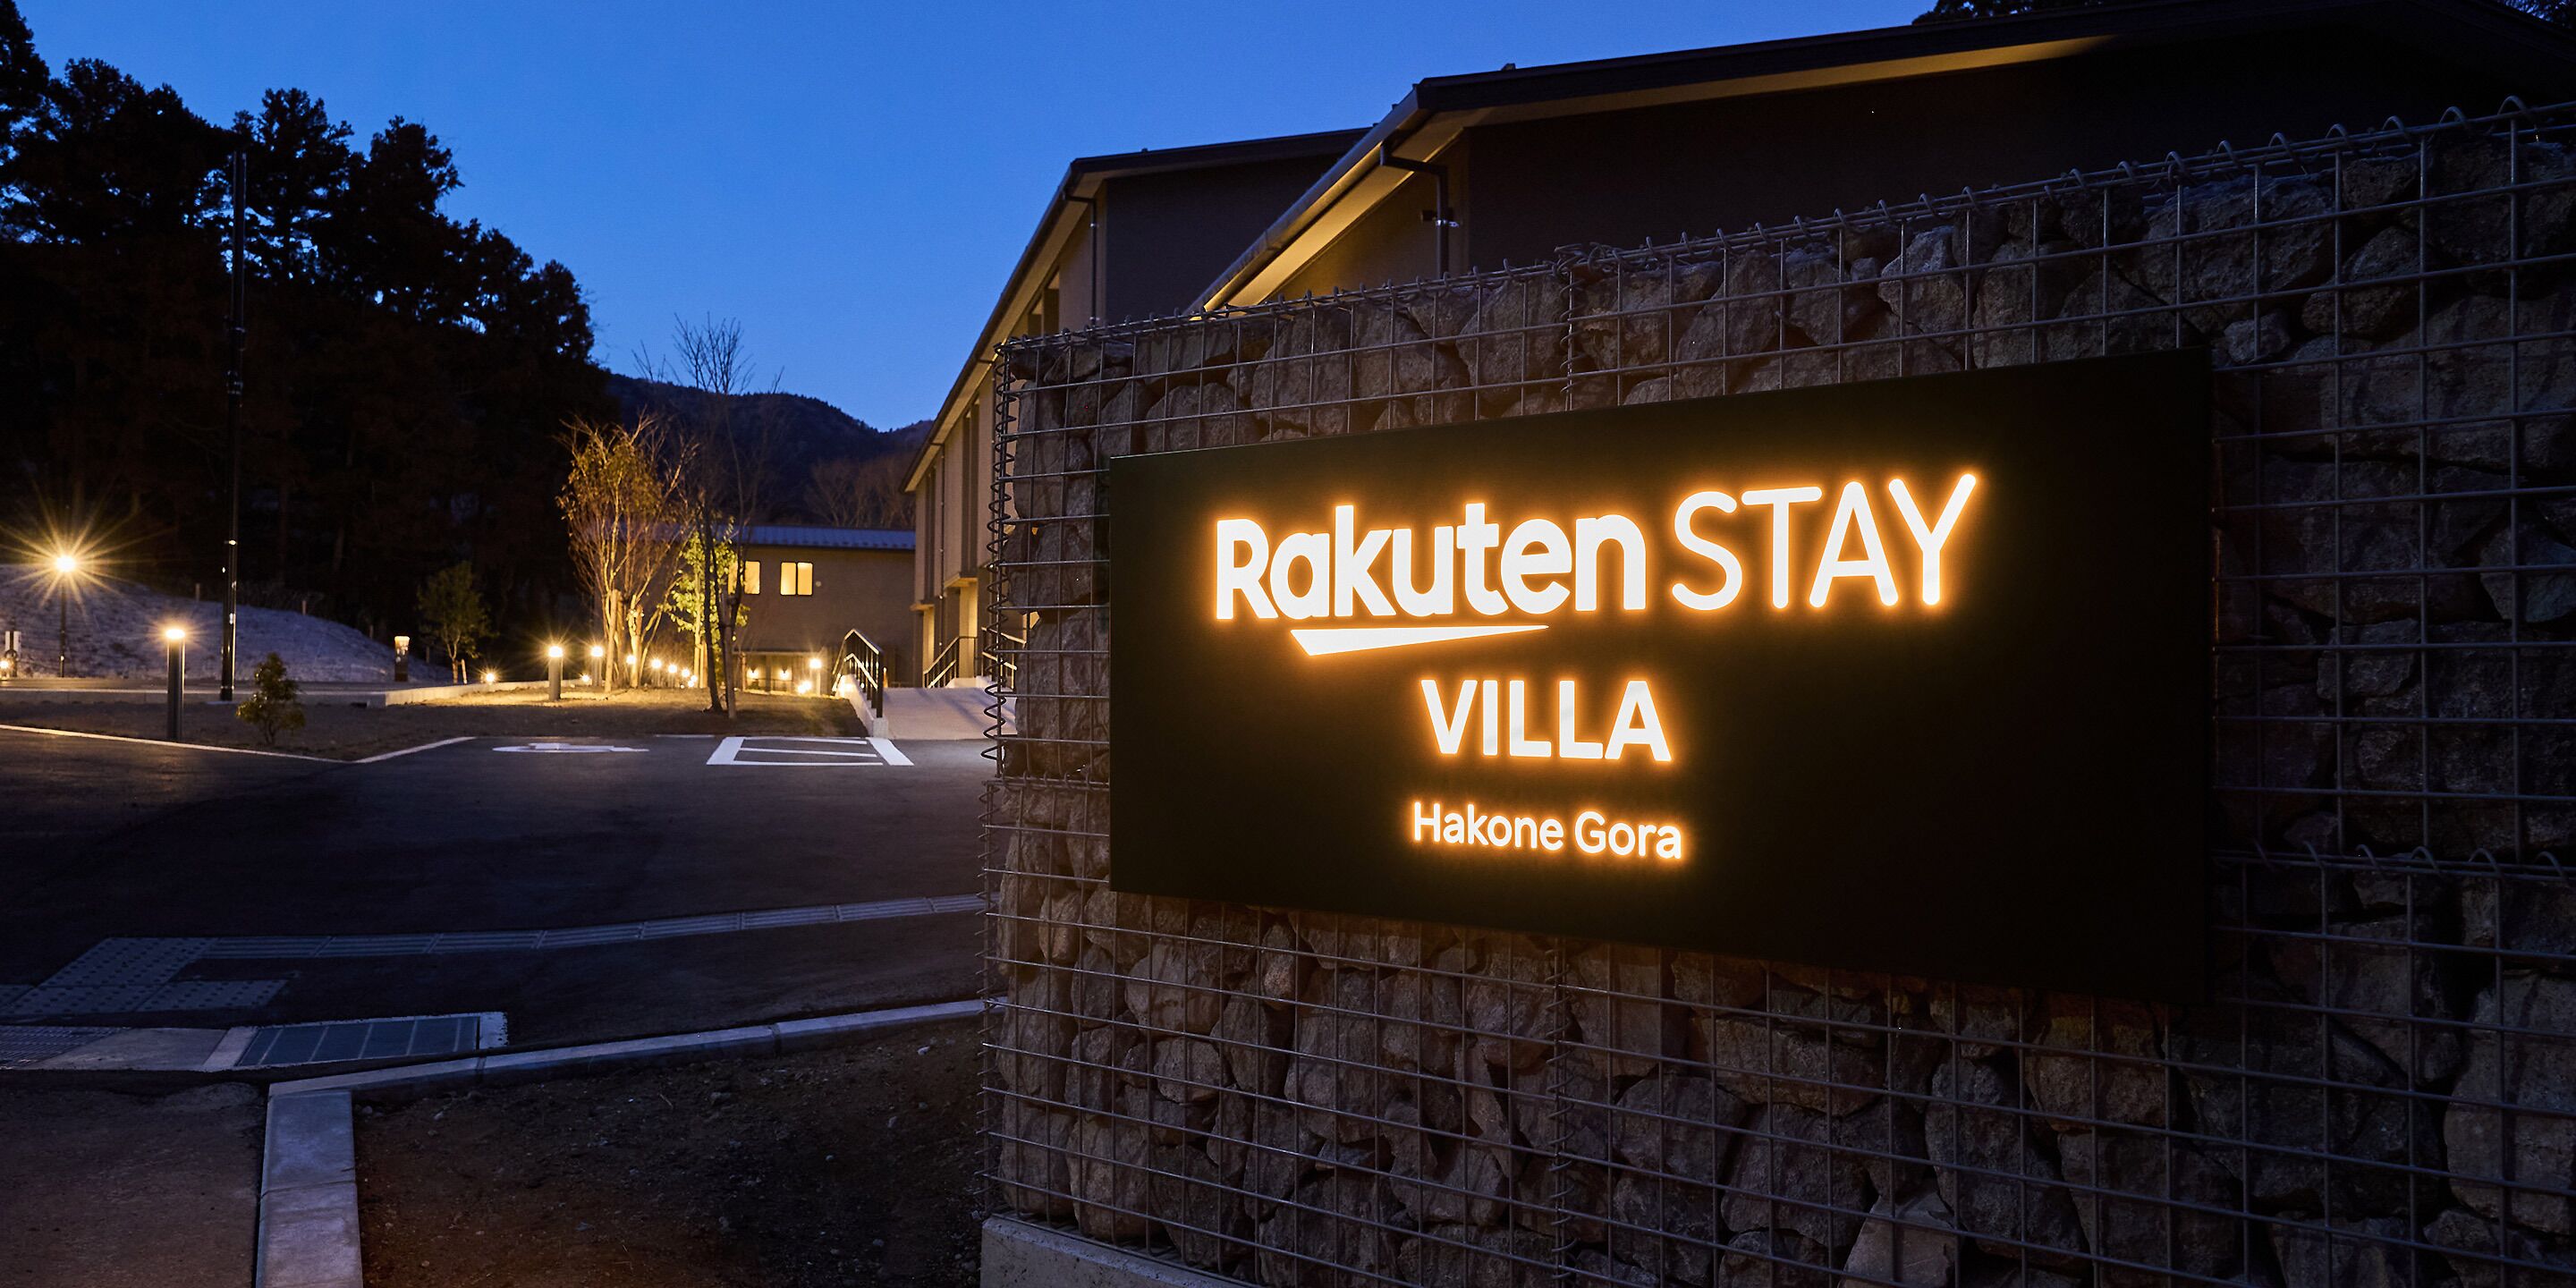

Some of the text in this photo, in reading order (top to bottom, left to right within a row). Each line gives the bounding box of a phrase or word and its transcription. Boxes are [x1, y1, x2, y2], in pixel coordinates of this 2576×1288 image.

[1214, 471, 1979, 623] Rakuten STAY
[1419, 678, 1674, 764] VILLA
[1411, 801, 1685, 860] Hakone Gora
